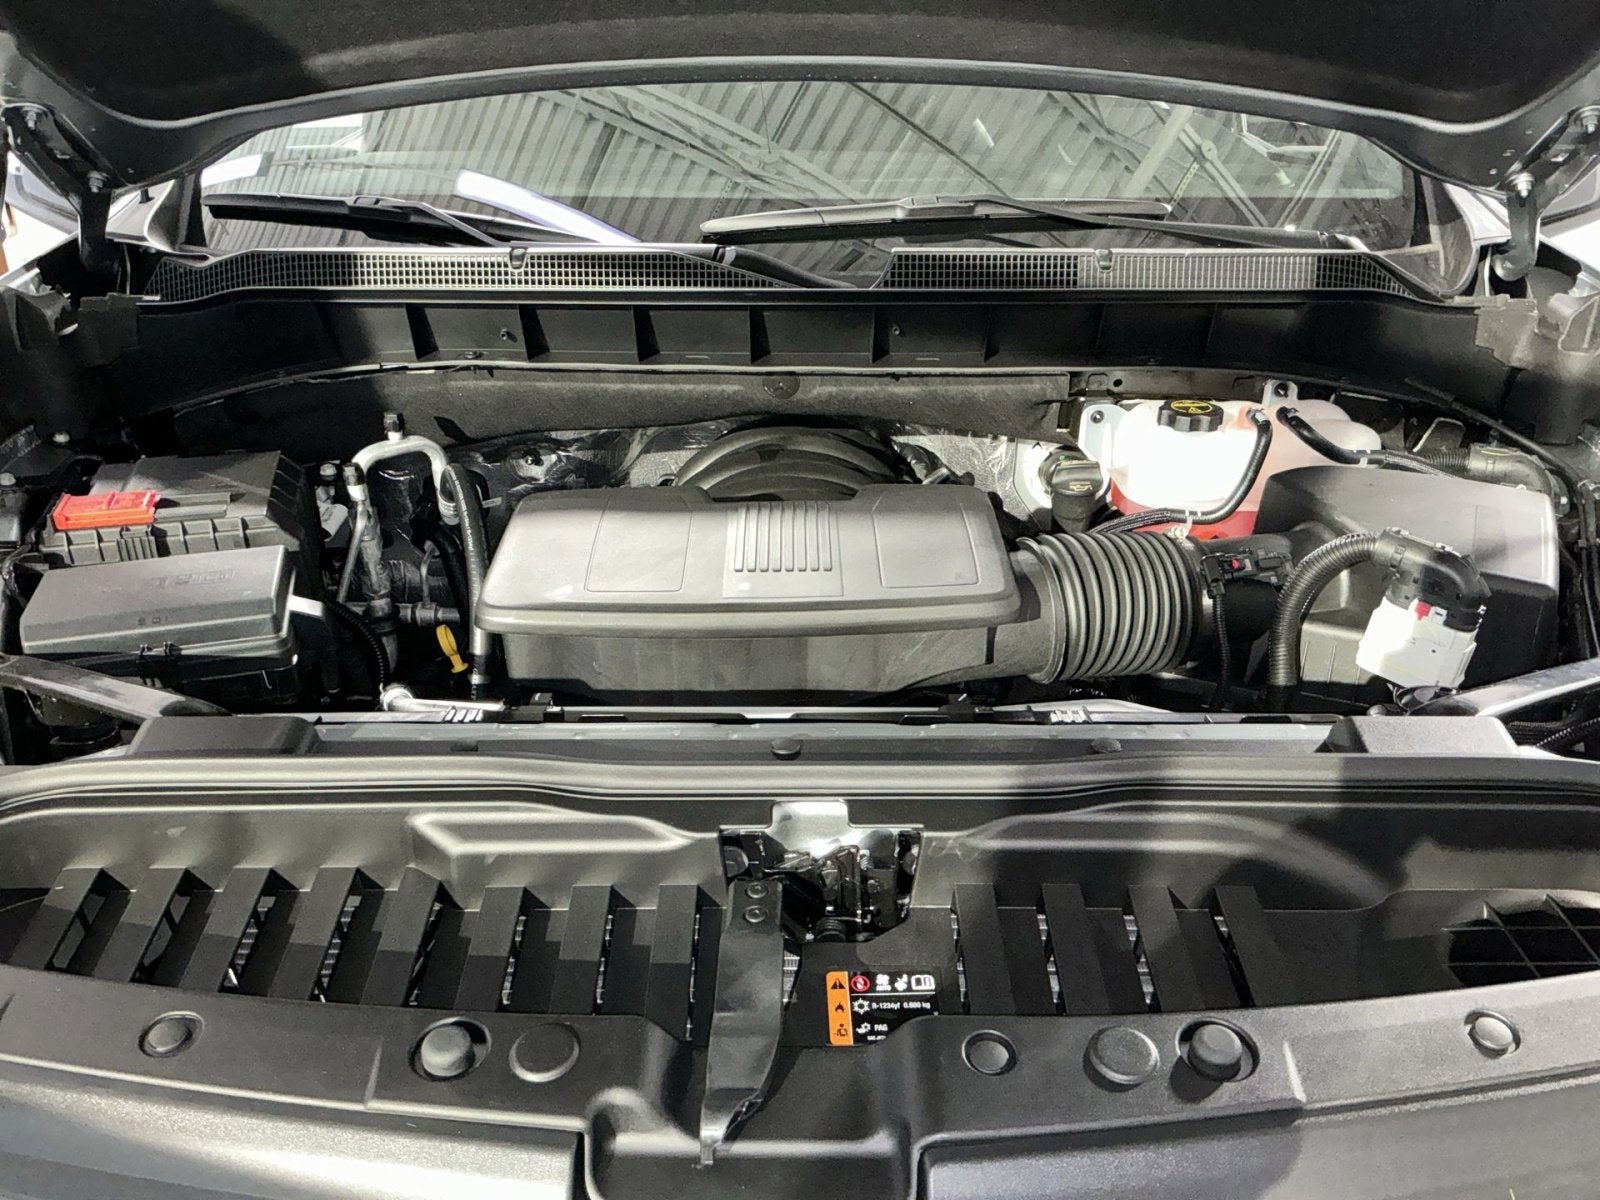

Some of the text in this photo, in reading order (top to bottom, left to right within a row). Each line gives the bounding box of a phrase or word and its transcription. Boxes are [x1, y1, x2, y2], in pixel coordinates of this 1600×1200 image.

[871, 1002, 900, 1010] R-1234yf
[922, 1001, 931, 1009] kg
[874, 1023, 888, 1032] PAG
